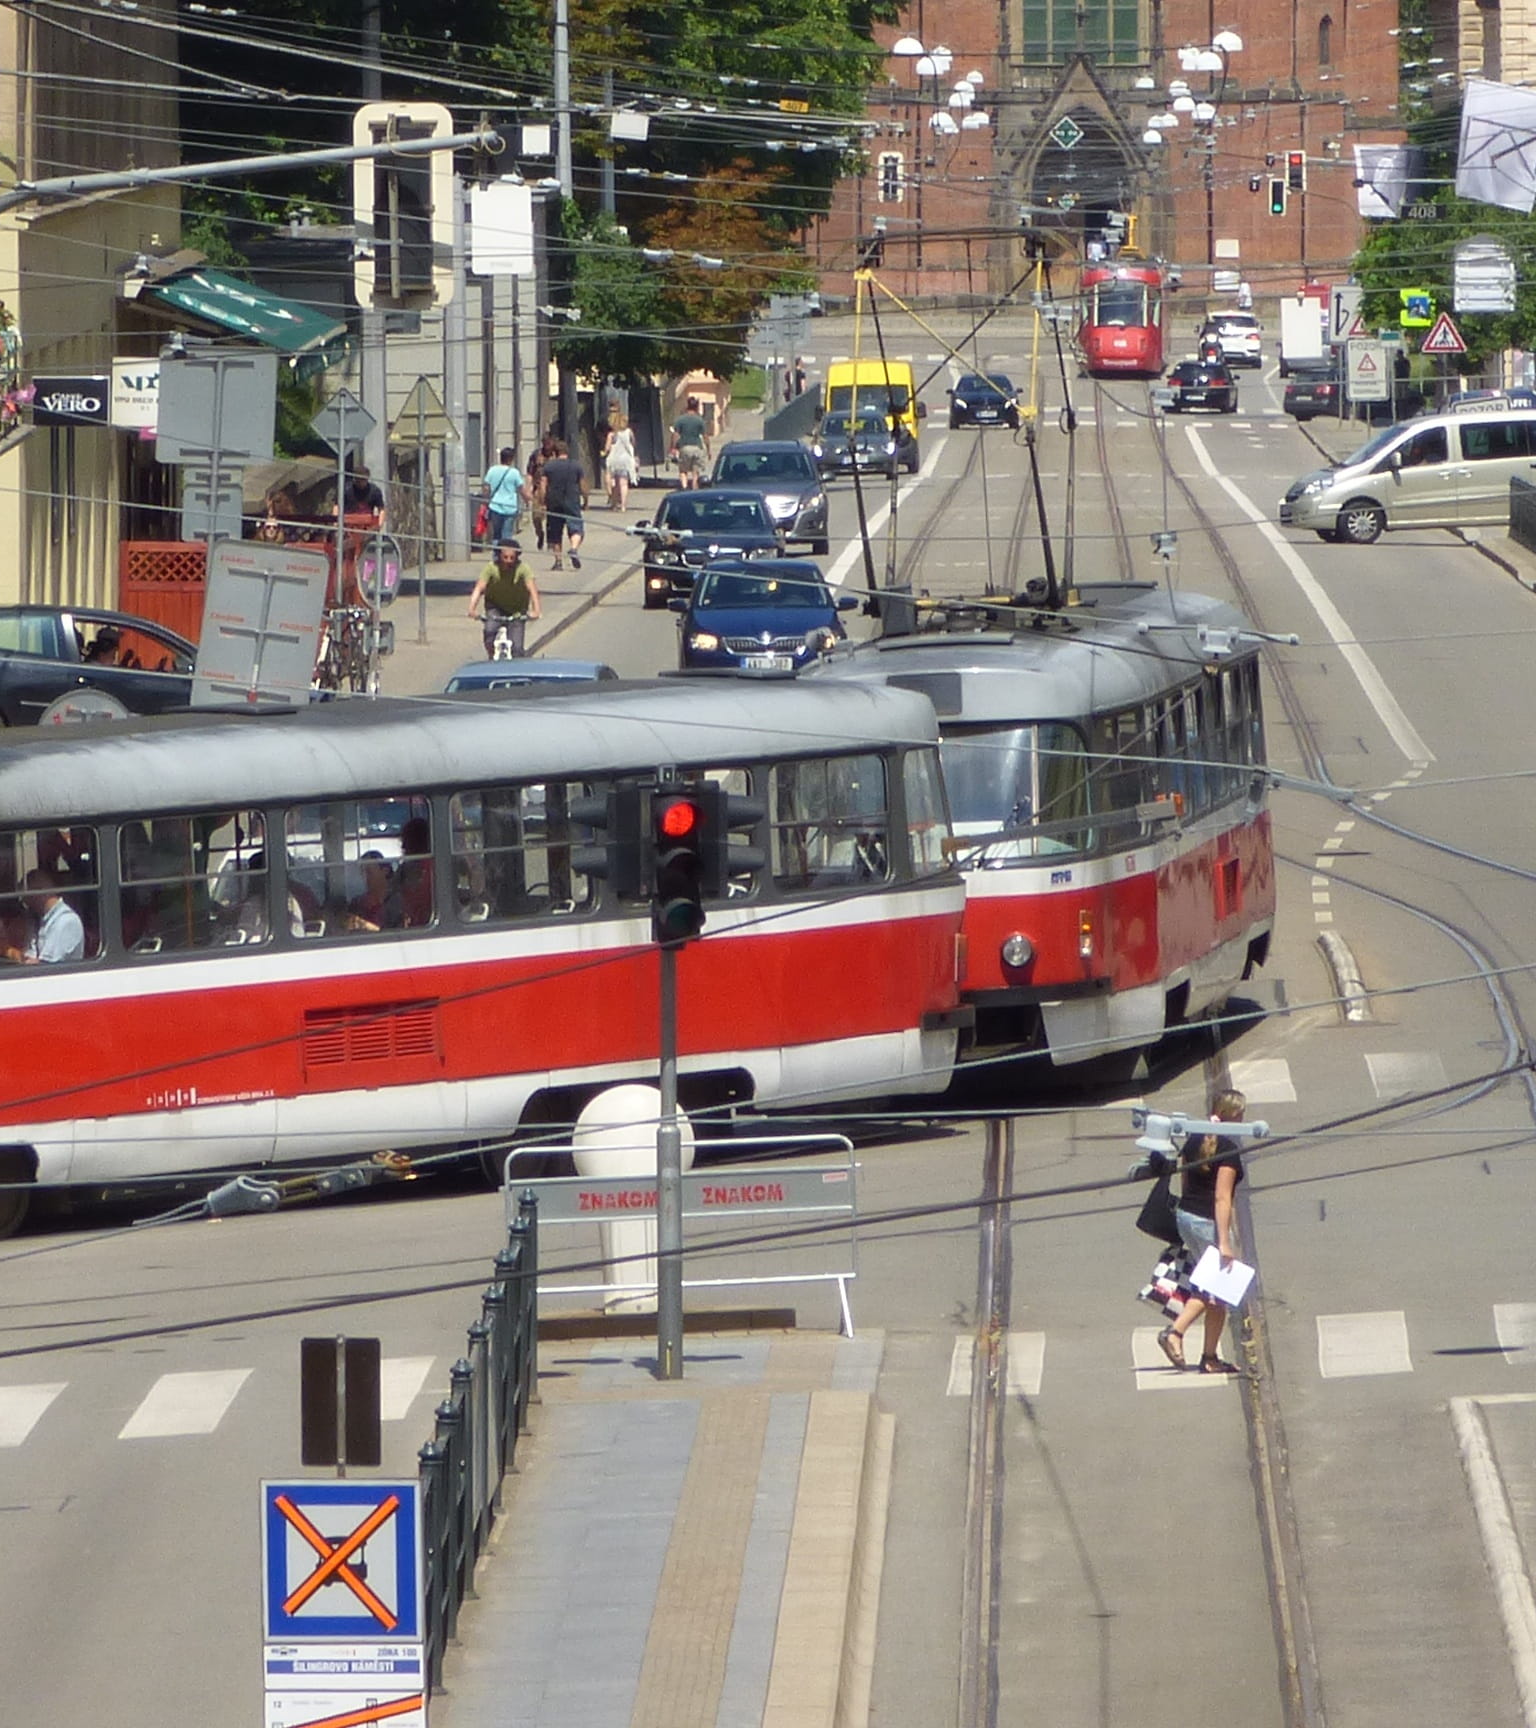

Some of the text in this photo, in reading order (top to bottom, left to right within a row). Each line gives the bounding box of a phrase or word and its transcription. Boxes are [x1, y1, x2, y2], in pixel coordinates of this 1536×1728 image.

[1407, 205, 1437, 219] 408
[578, 1183, 785, 1212] ZNAKOM ZNAKOM
